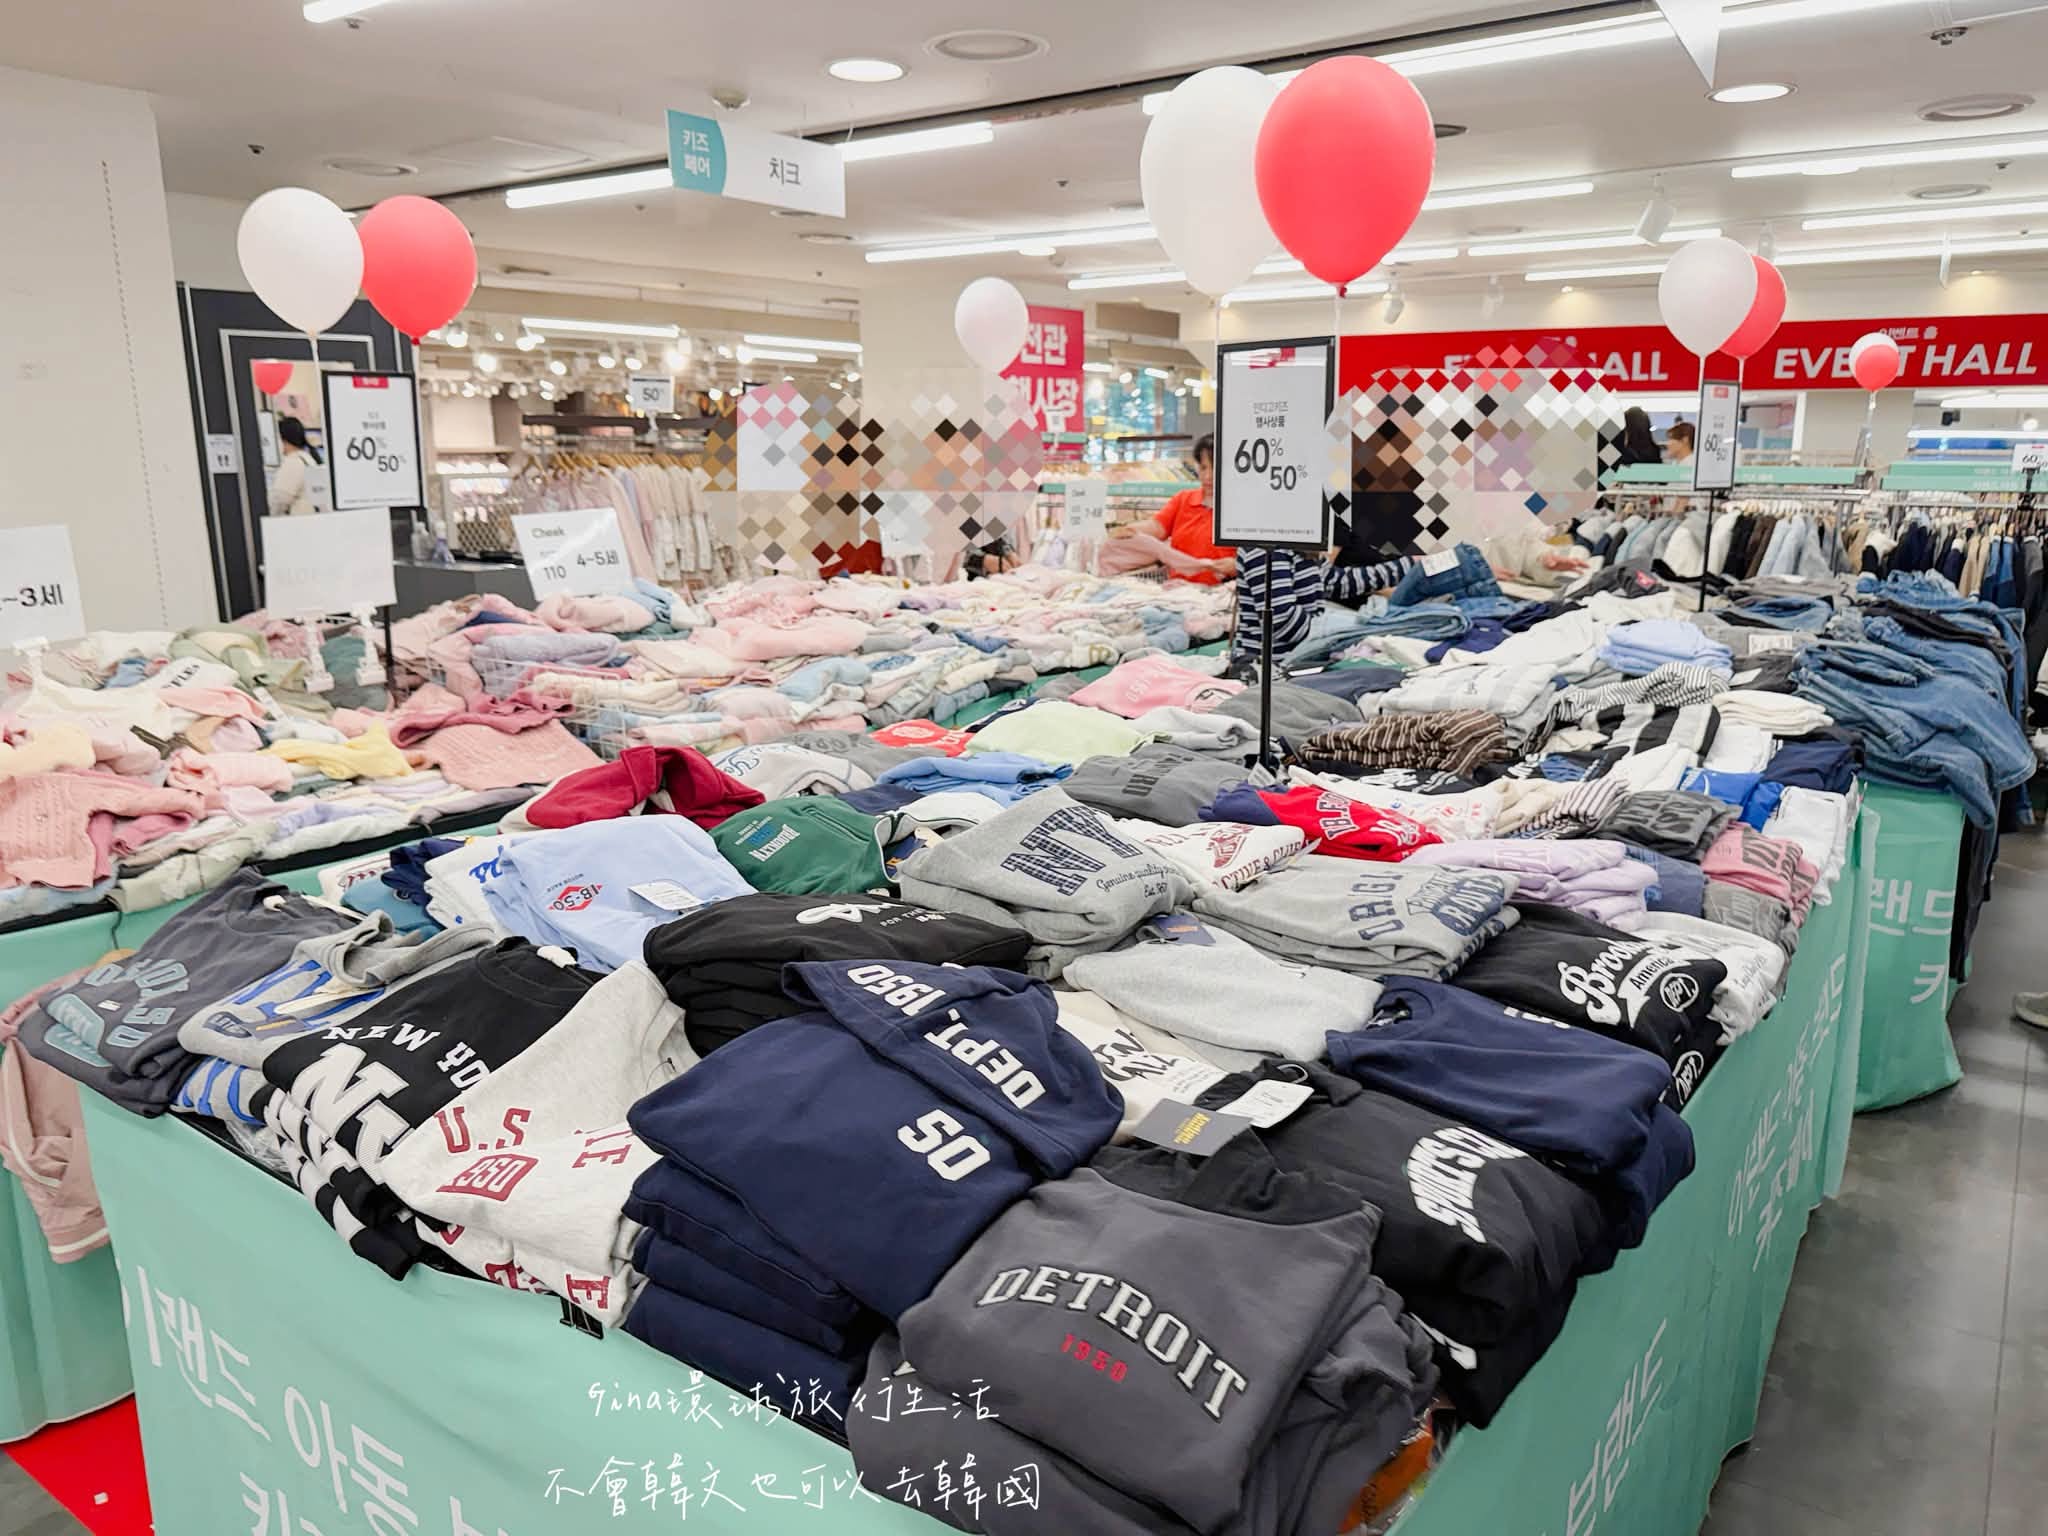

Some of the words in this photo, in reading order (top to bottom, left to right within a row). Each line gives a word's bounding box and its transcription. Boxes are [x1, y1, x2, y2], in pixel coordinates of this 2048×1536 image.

[682, 130, 710, 152] 키즈
[769, 158, 801, 185] 치크
[1774, 345, 1917, 380] EVET
[1921, 342, 2038, 377] HALL
[544, 566, 567, 580] 110
[576, 549, 619, 567] 4-5세
[0, 583, 64, 612] -3세
[847, 964, 948, 1017] 1950
[321, 1022, 441, 1053] NEW
[436, 1041, 493, 1094] YO
[923, 1008, 1047, 1110] DEPT.
[975, 1265, 1248, 1424] DETROIT
[1060, 1333, 1129, 1383] 1950
